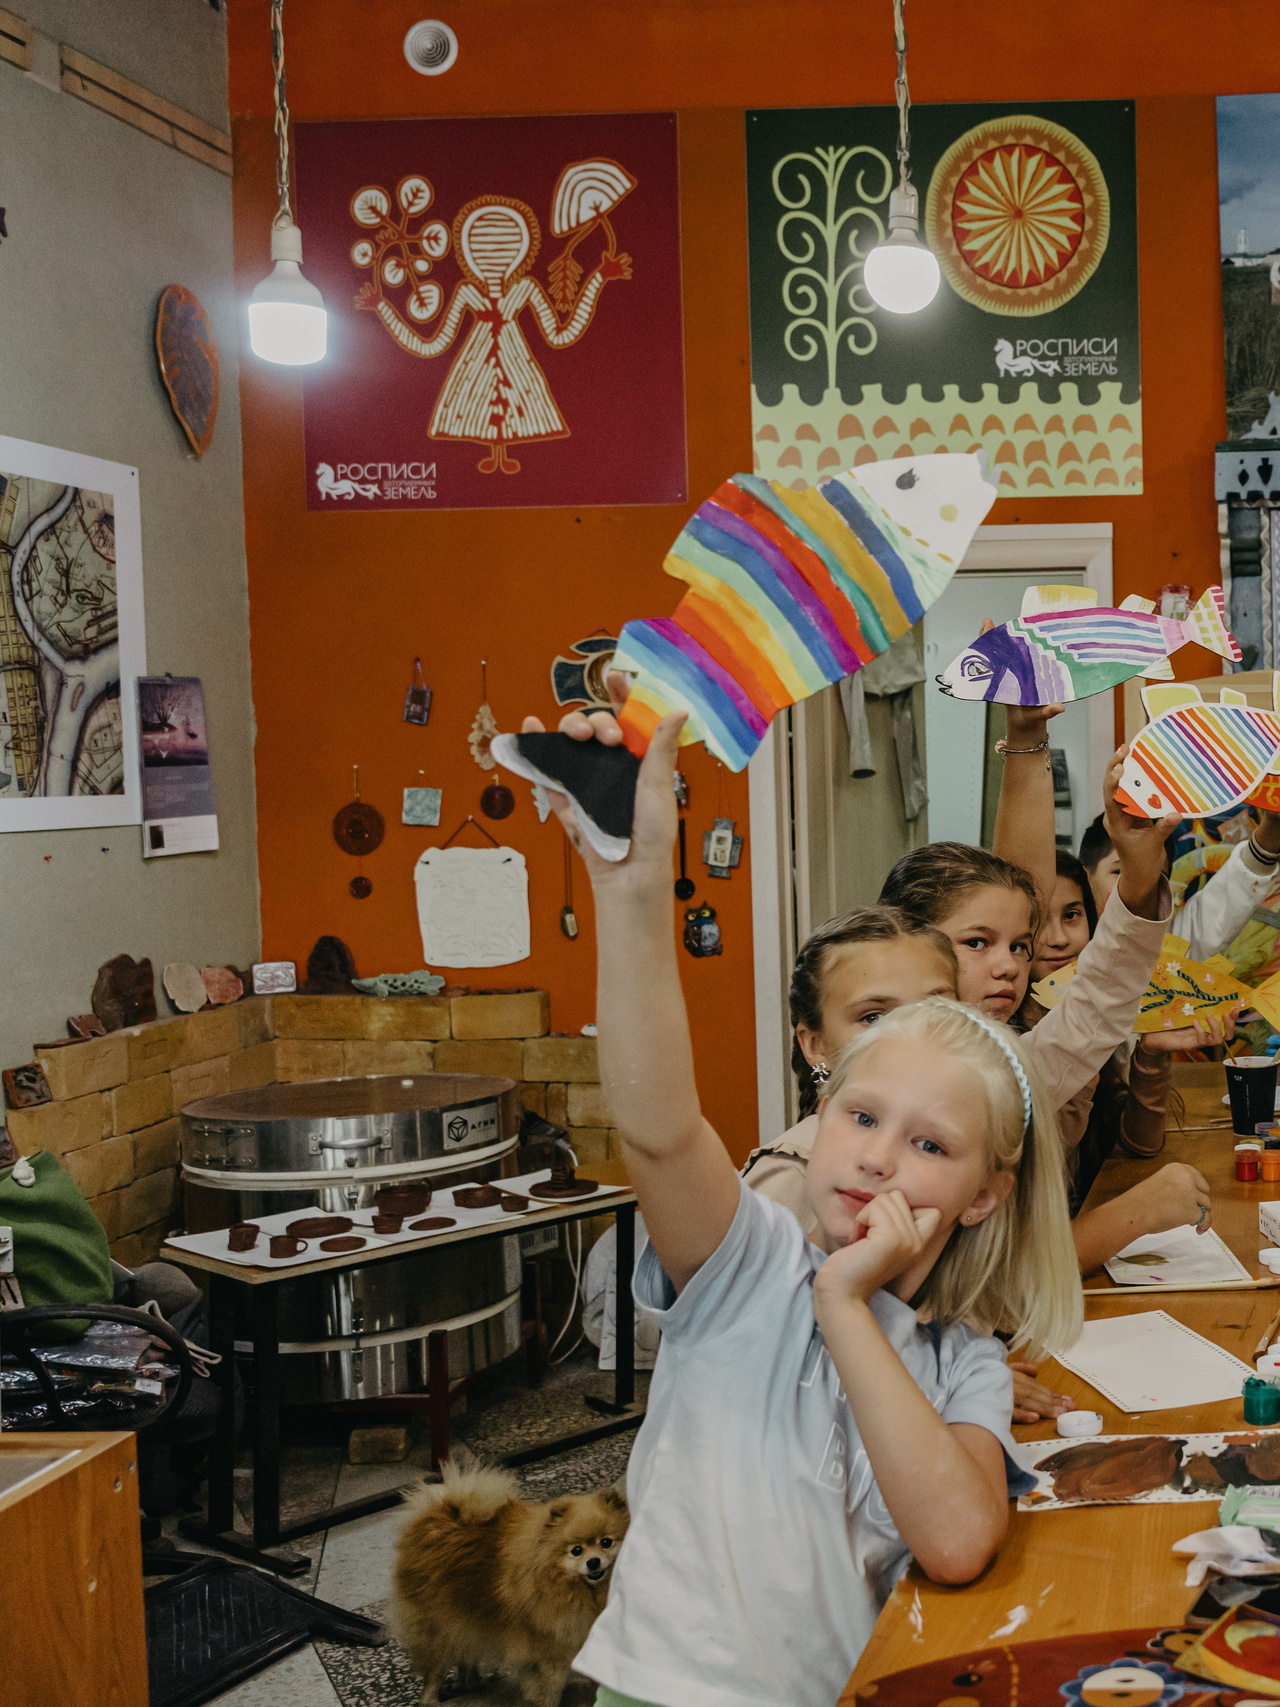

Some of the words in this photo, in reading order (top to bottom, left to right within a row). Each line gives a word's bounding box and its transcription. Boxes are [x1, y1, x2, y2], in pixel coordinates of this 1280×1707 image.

[1016, 337, 1118, 357] РОСПИСИ
[1063, 362, 1118, 376] ЗЕМЕЛЬ
[337, 462, 437, 481] РОСПИСИ
[383, 486, 437, 500] ЗЕМЕЛЬ
